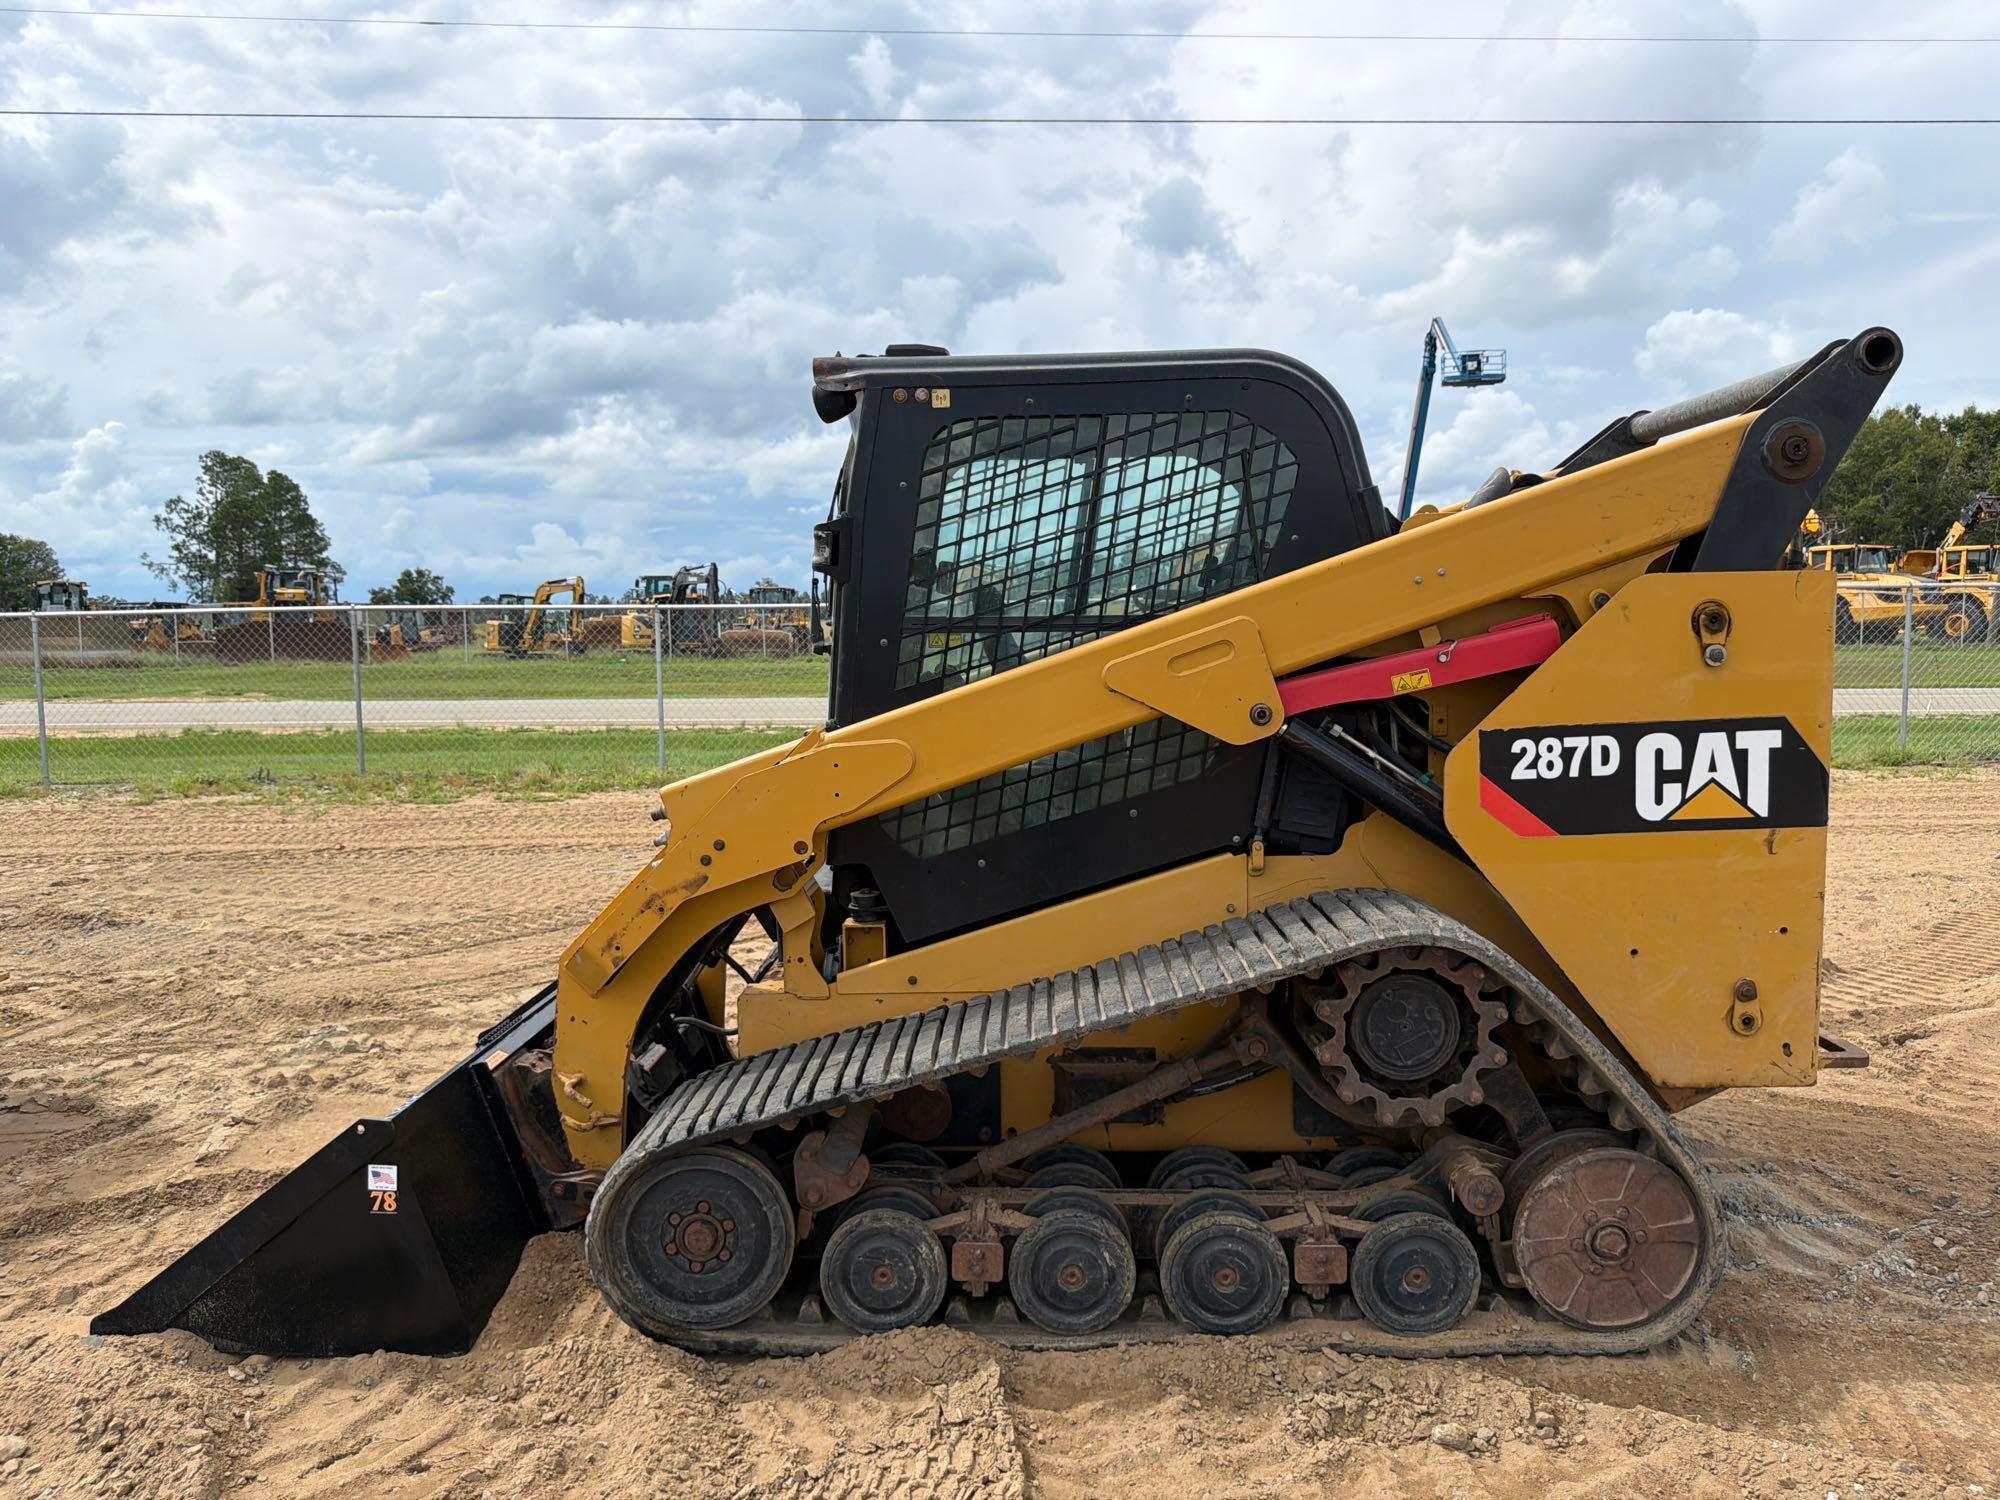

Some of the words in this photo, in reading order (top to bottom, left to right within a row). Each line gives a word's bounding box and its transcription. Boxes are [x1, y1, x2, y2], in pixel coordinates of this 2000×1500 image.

[1510, 735, 1620, 780] 287D
[1635, 729, 1782, 822] CAT
[370, 1191, 397, 1212] 78
